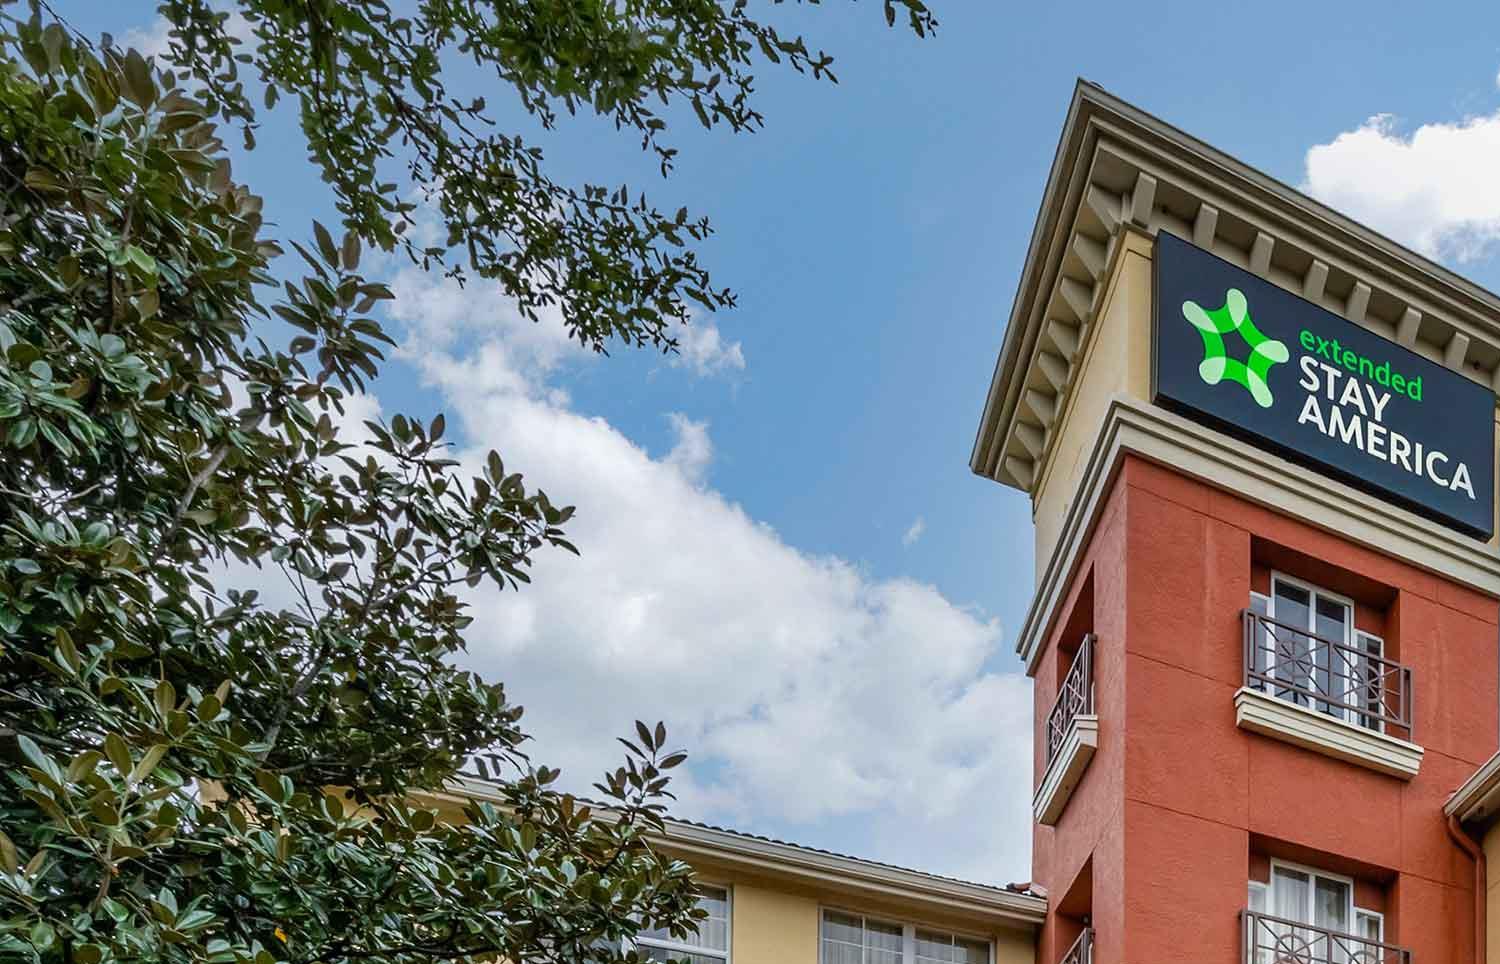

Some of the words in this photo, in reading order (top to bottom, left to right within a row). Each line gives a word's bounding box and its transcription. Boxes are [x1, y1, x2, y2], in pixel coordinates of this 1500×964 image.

[1299, 330, 1423, 401] extended
[1299, 355, 1391, 422] STAY
[1298, 394, 1476, 500] AMERICA
